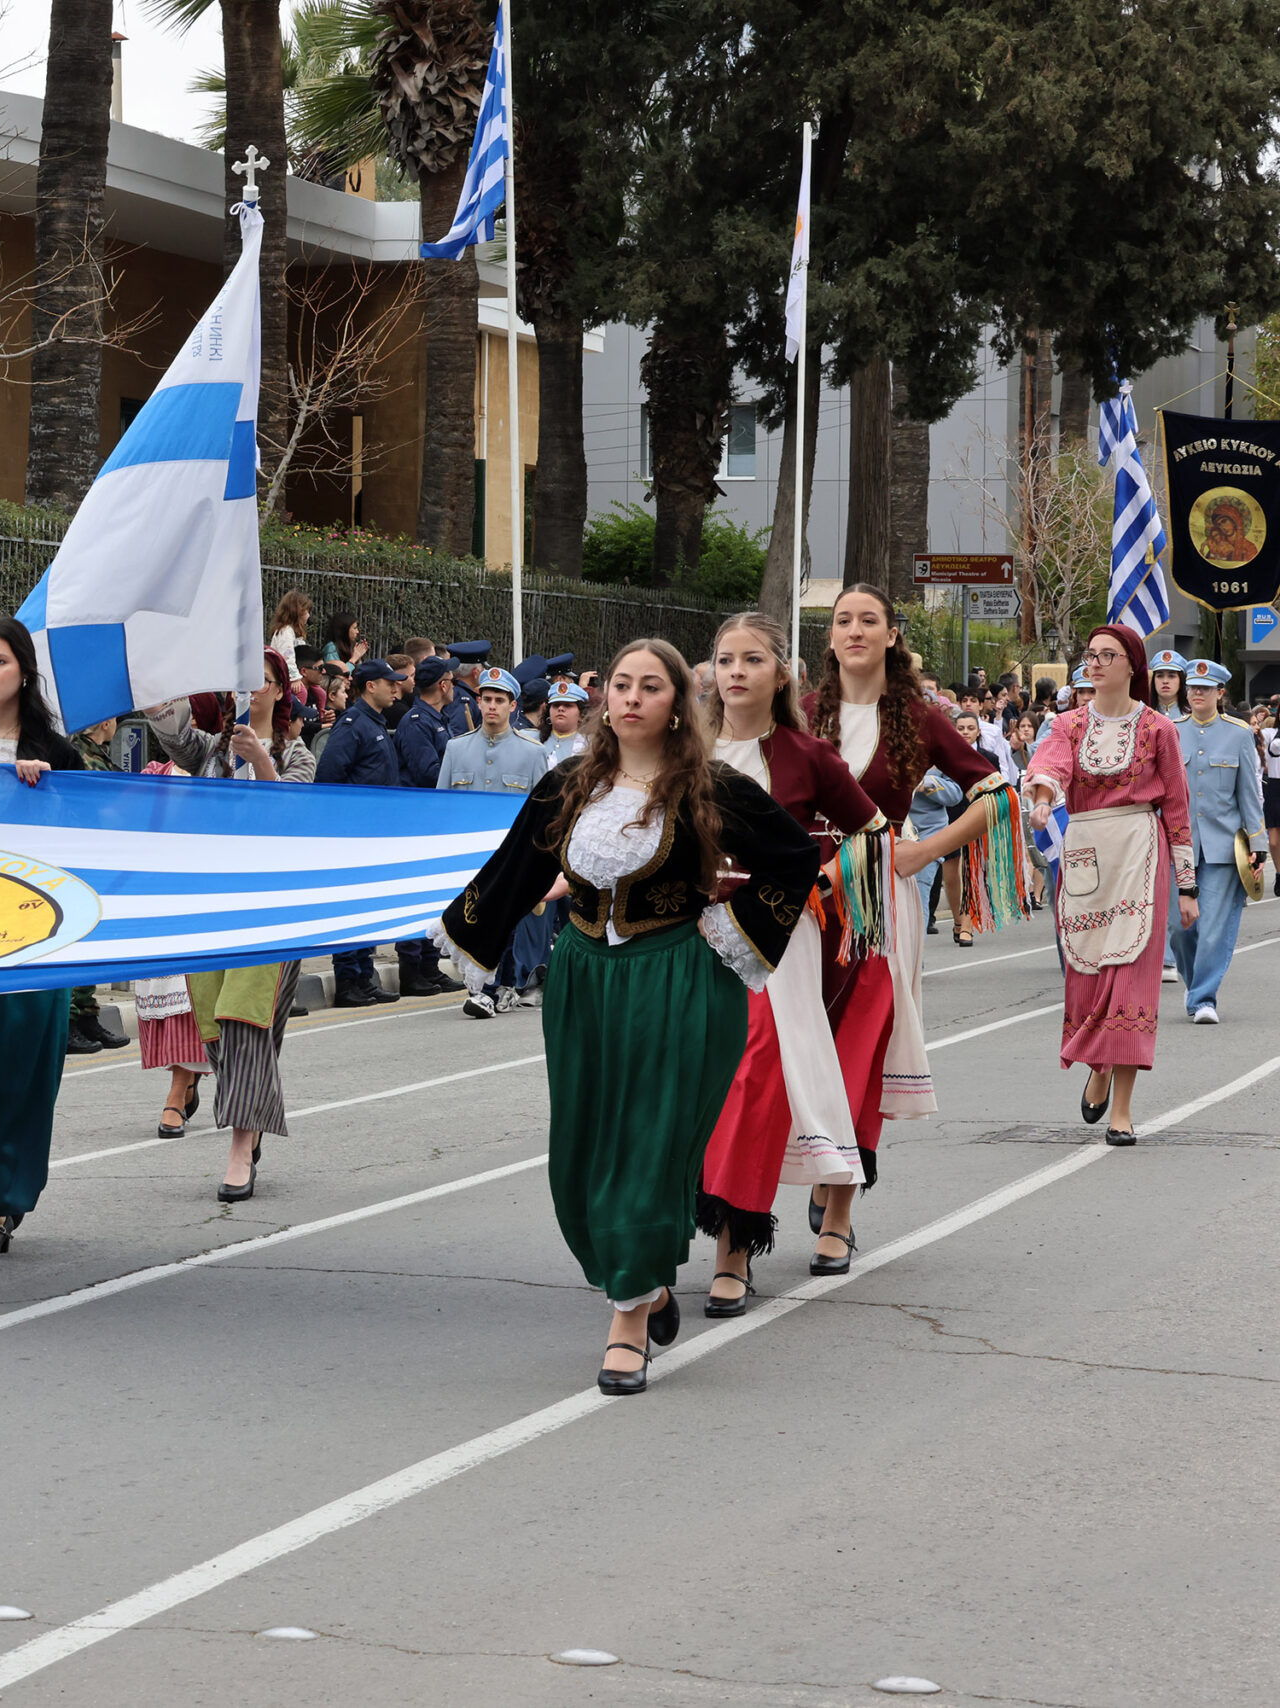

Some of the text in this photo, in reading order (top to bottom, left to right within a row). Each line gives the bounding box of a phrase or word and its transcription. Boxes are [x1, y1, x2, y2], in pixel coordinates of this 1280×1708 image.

[1173, 438, 1276, 462] ΛΥΚΕΙΟ ΚΥΚΚΟΥ
[1212, 581, 1248, 593] 1961
